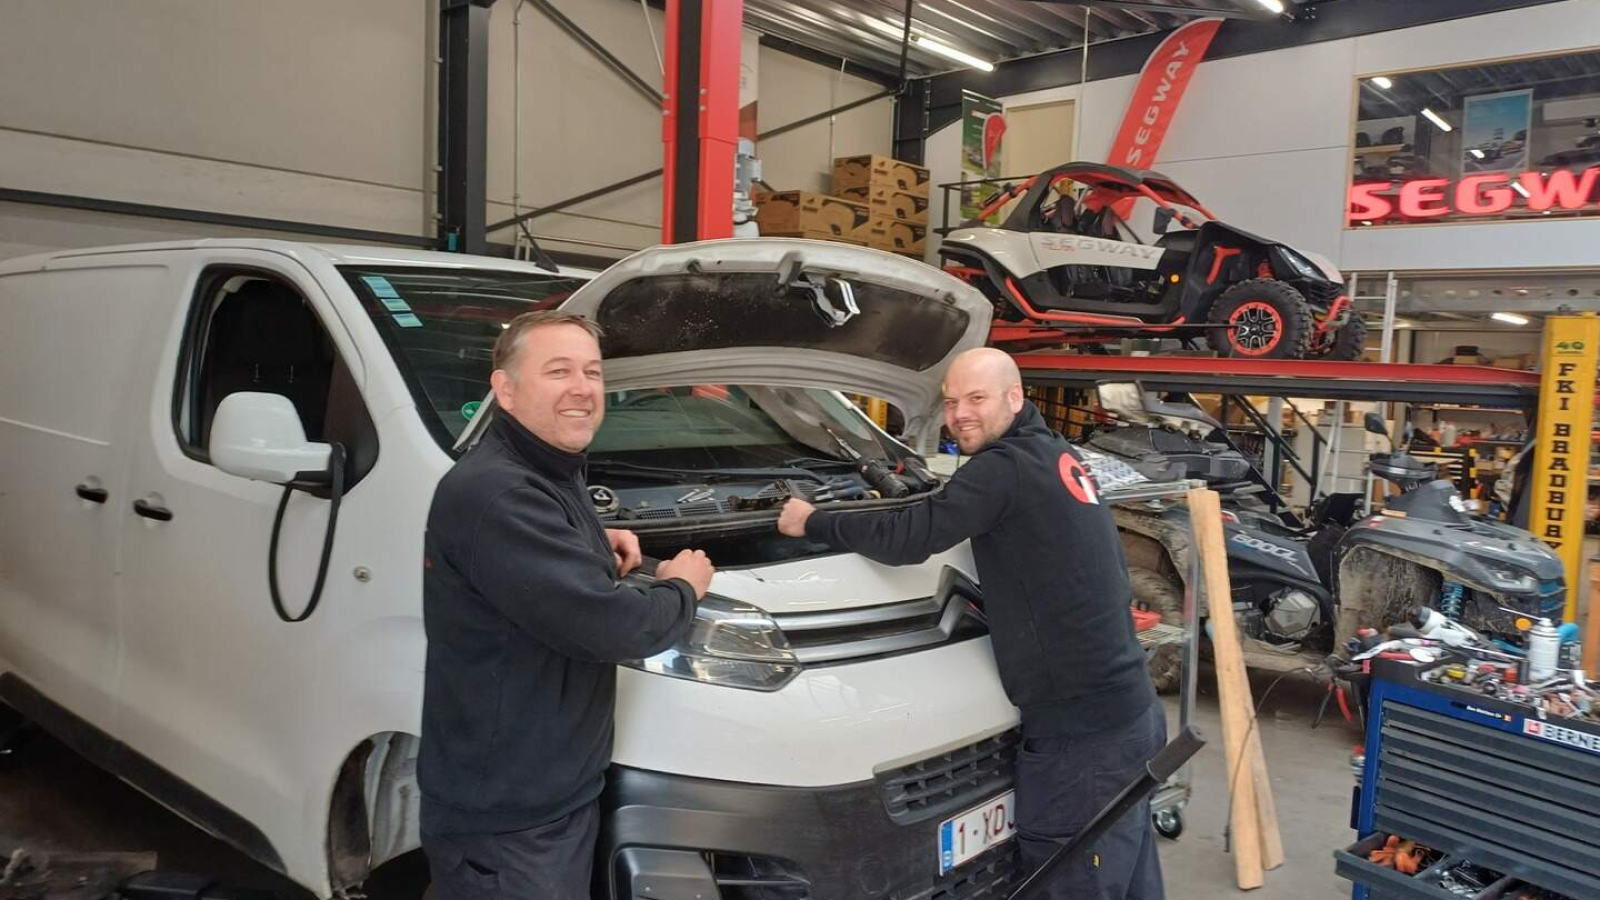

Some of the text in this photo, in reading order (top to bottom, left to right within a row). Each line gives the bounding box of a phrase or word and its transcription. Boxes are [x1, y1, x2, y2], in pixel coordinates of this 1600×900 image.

[1126, 41, 1190, 166] SEGWAY
[1348, 166, 1600, 221] SEGW
[1040, 235, 1157, 259] SEGWAY
[1556, 362, 1577, 411] FKI
